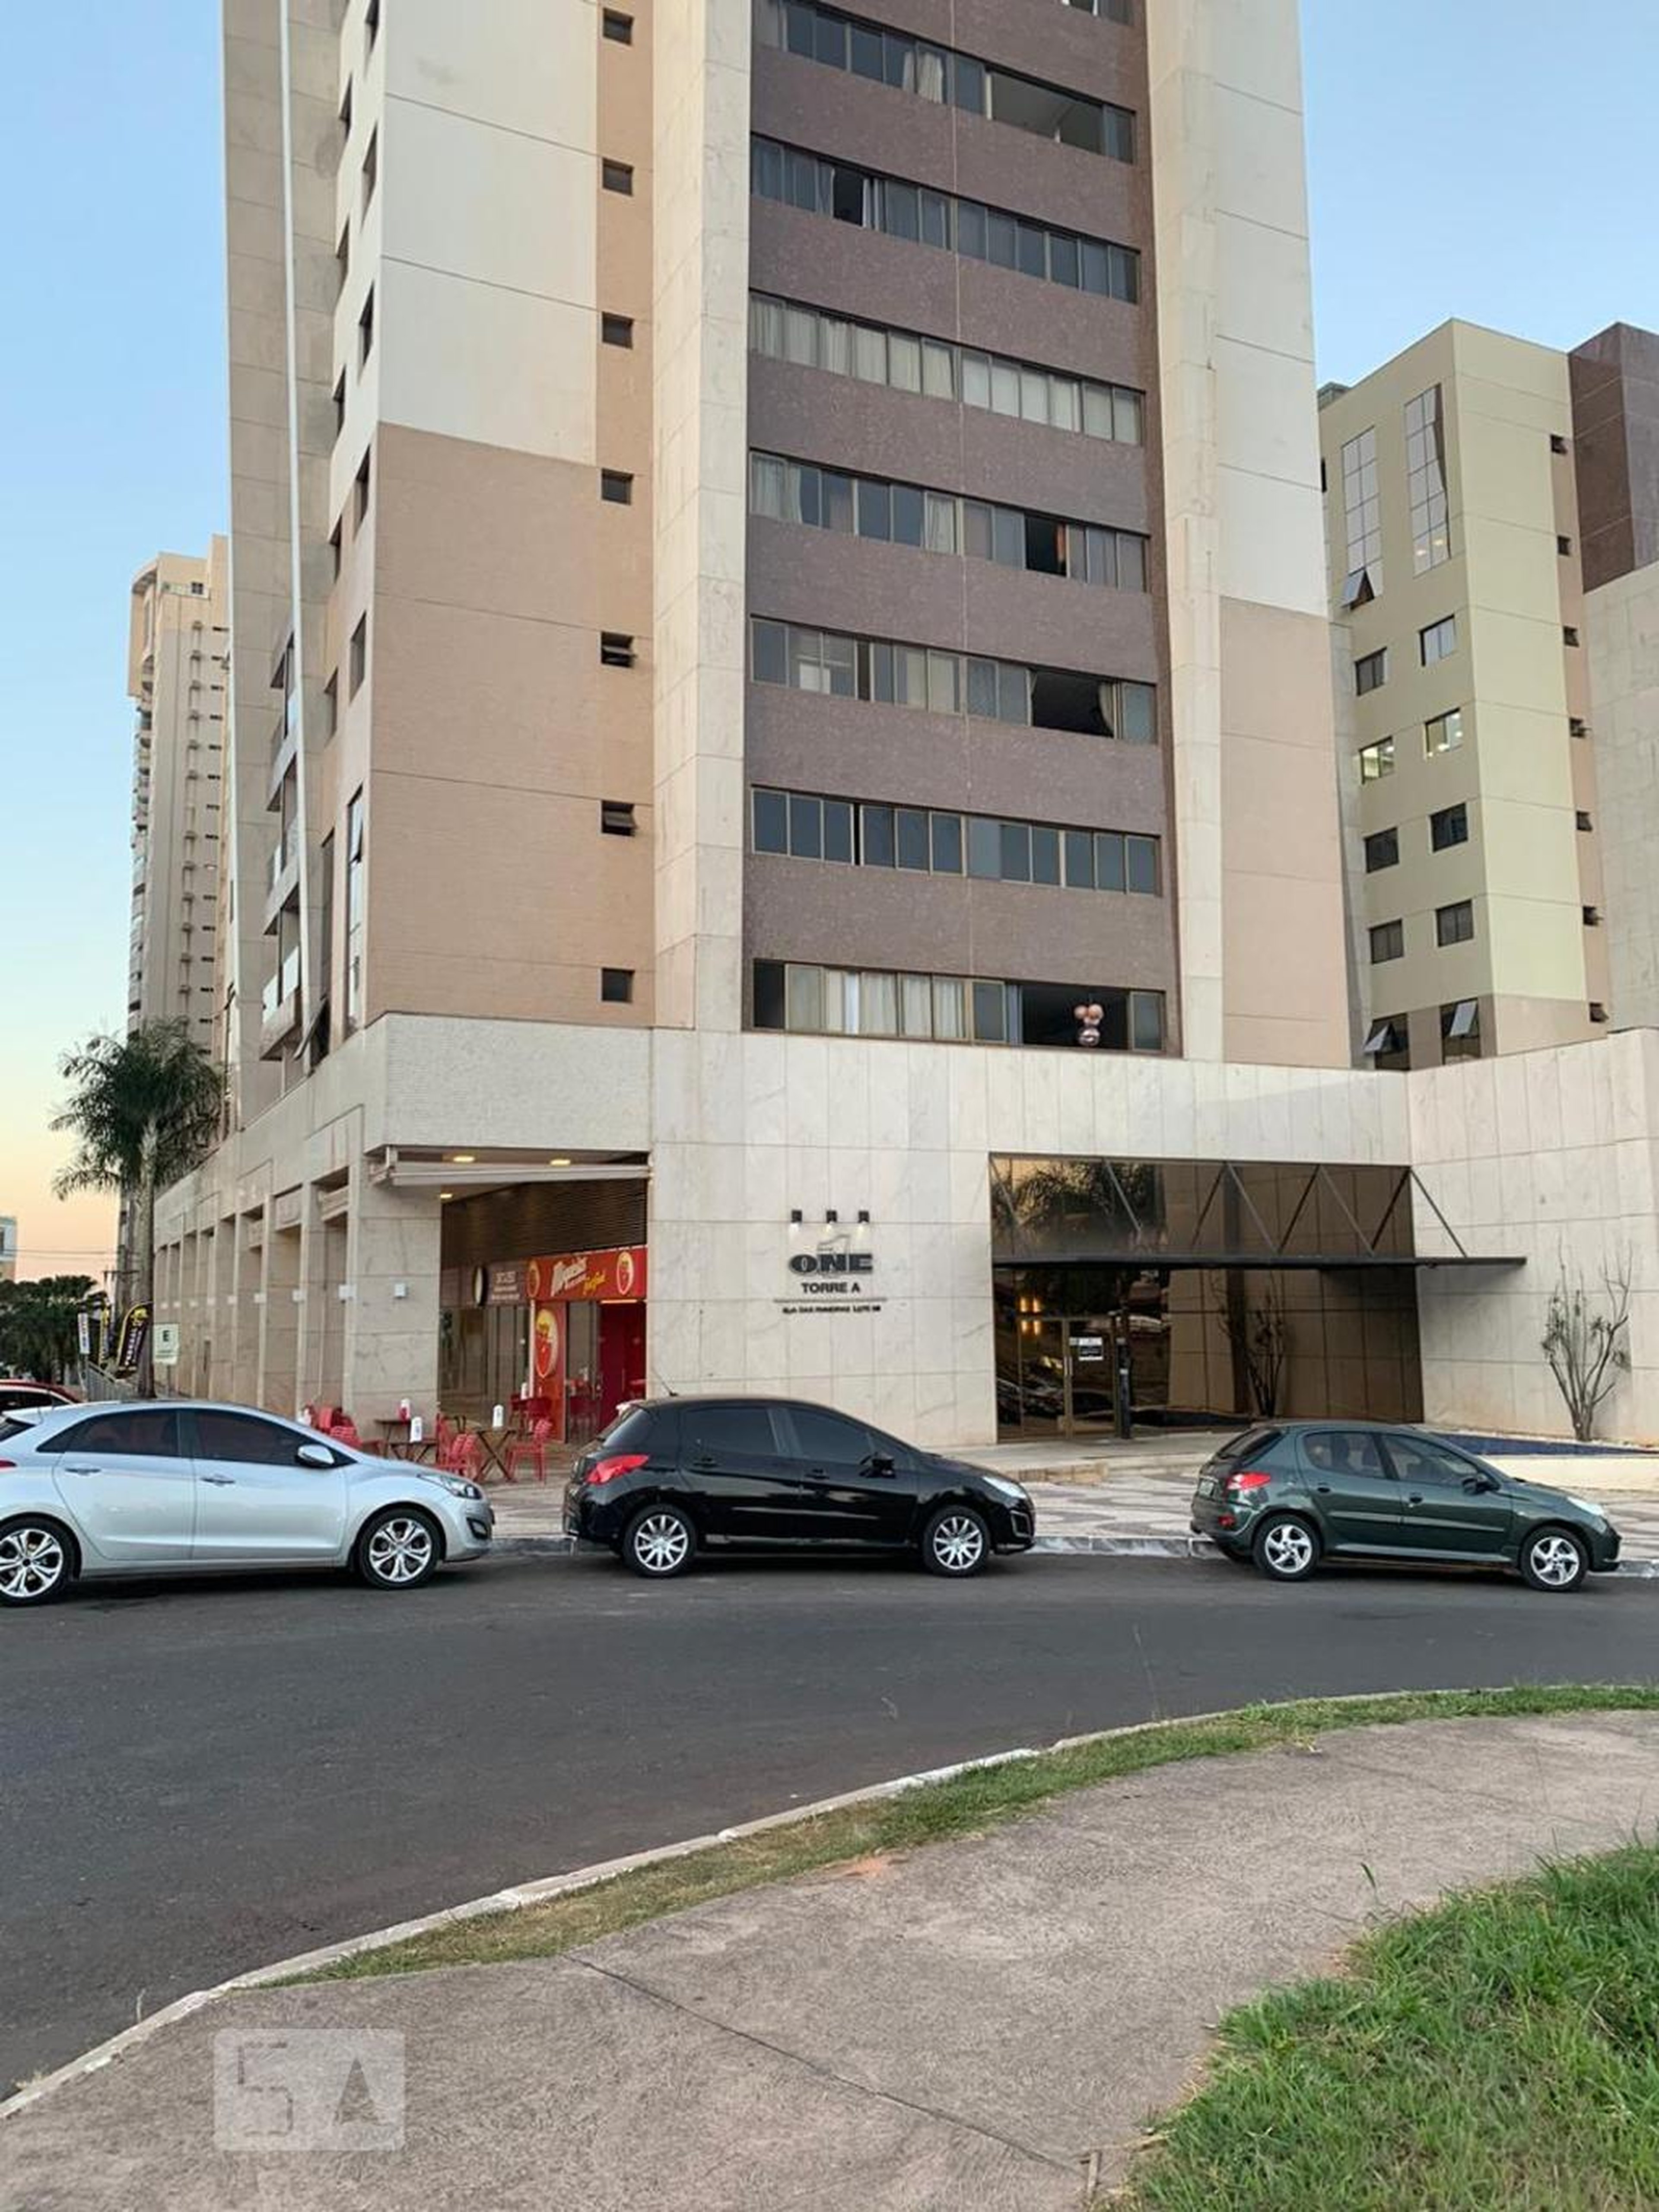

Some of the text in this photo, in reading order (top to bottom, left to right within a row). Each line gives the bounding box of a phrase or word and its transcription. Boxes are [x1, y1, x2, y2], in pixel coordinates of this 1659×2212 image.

[789, 1254, 873, 1274] ONE
[801, 1283, 861, 1293] TORRE A
[162, 1330, 169, 1342] E
